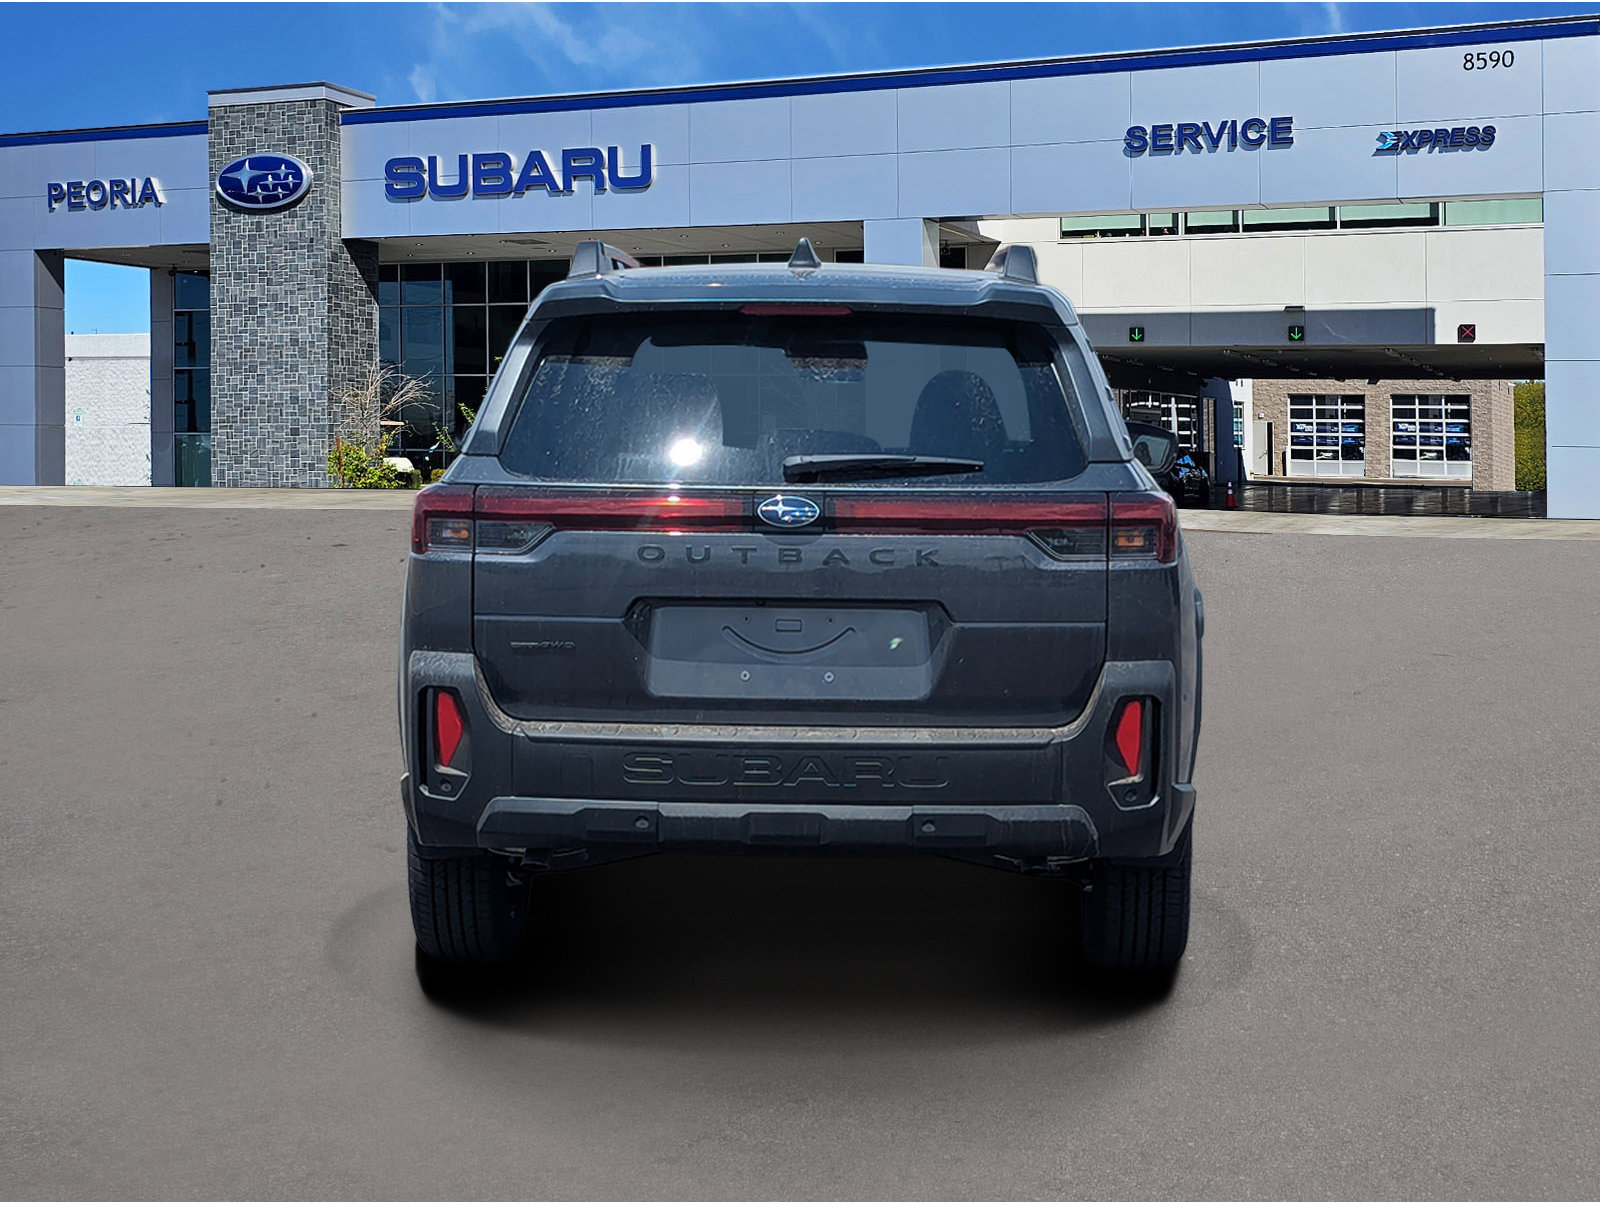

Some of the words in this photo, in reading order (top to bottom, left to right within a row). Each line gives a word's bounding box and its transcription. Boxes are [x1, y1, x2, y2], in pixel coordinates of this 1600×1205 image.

[1463, 50, 1514, 71] 8590
[1125, 116, 1294, 153] SERVICE
[1376, 125, 1496, 151] EXPRESS
[384, 144, 652, 200] SUBARU
[47, 177, 163, 211] PEORIA
[637, 545, 940, 567] OUTBACK
[623, 752, 950, 789] SUBARU
